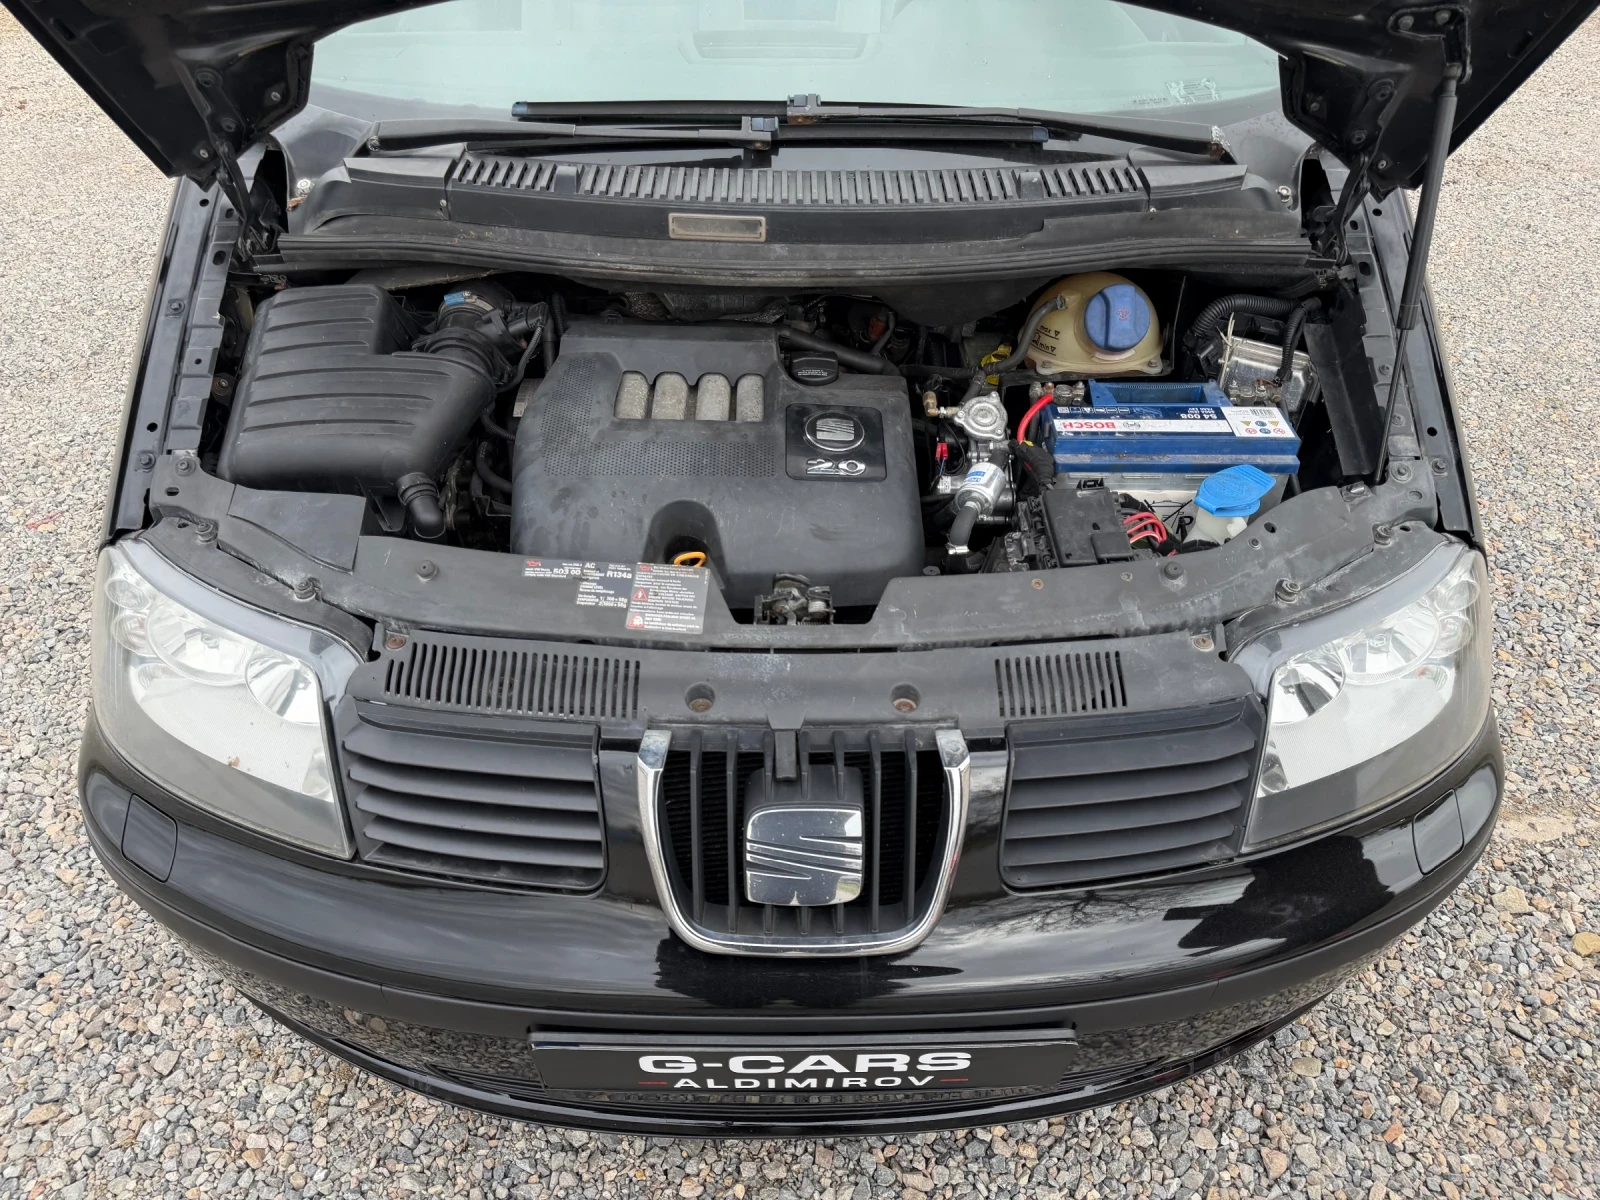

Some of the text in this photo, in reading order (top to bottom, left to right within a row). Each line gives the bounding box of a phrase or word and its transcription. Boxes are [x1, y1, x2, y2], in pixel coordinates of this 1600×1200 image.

[1040, 325, 1051, 334] max
[1039, 342, 1049, 351] min
[1062, 421, 1116, 429] BOSCH
[606, 570, 632, 579] R134a
[638, 1052, 972, 1074] G-CARS
[673, 1075, 935, 1089] ALDIMIROV
